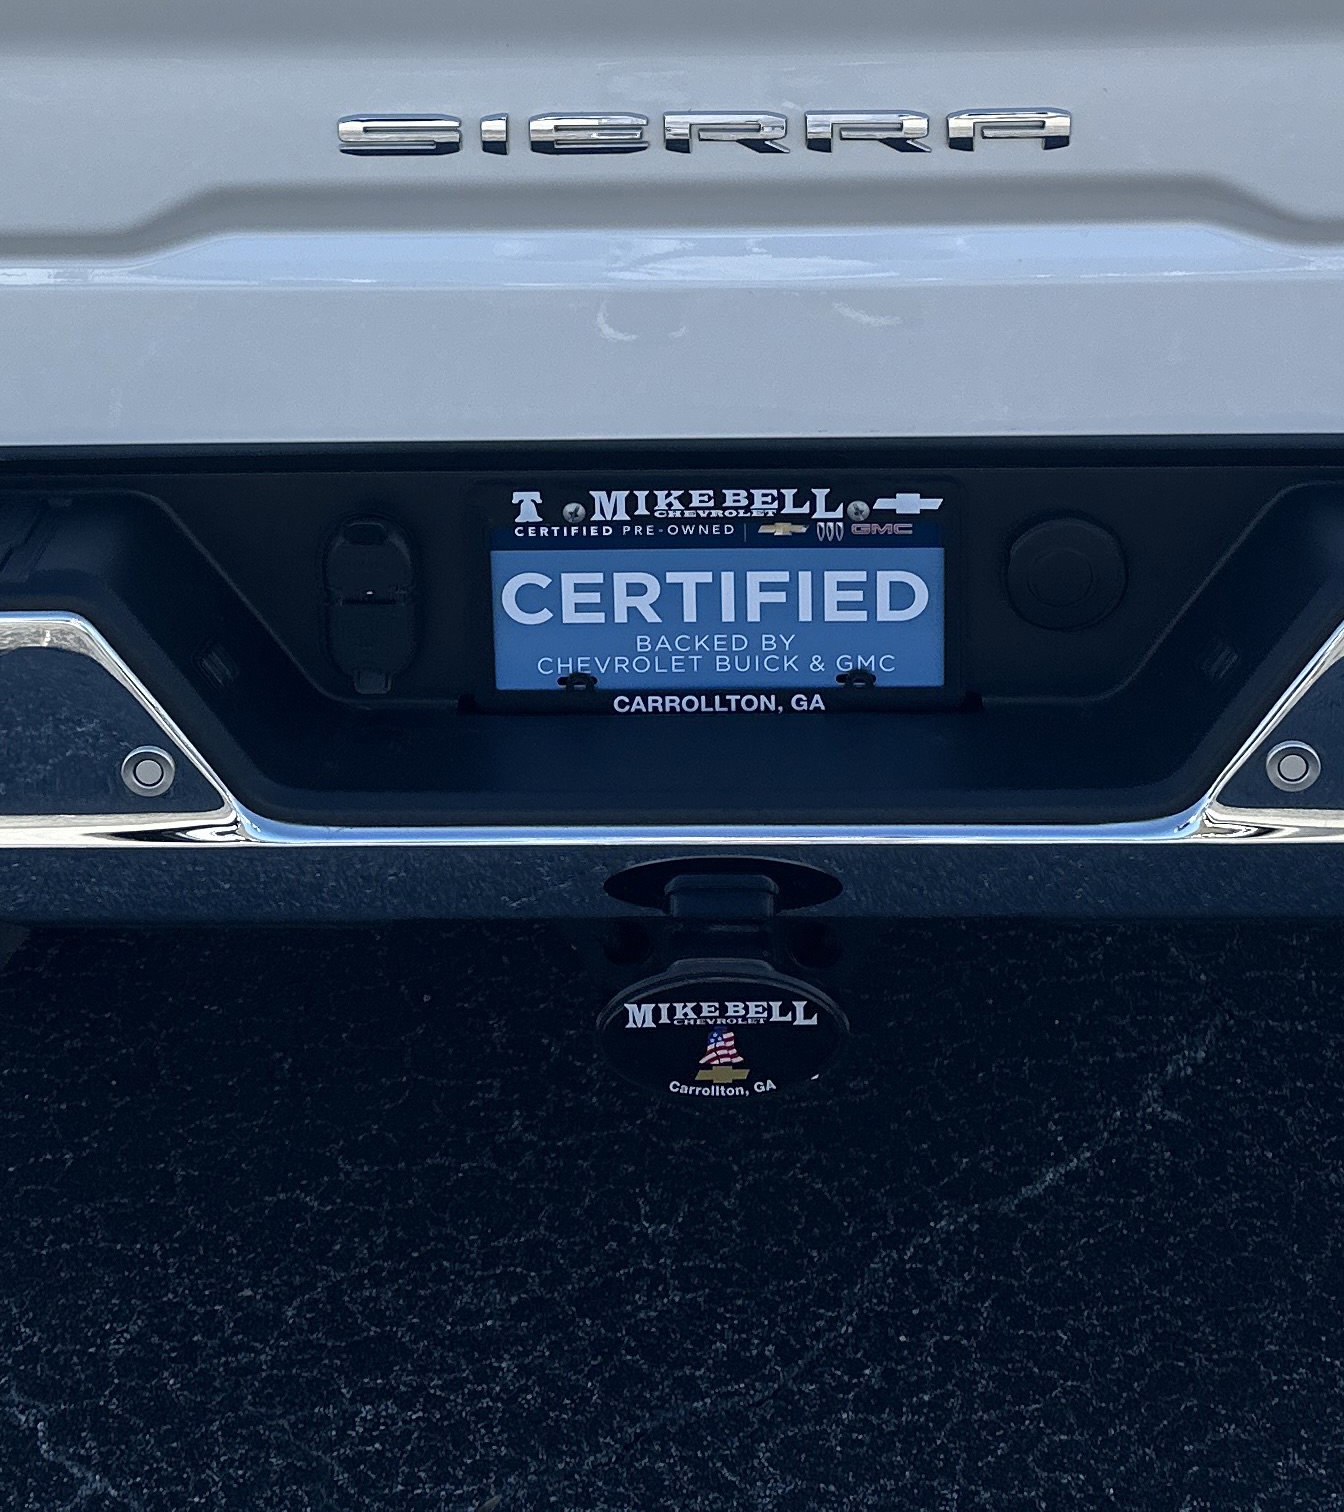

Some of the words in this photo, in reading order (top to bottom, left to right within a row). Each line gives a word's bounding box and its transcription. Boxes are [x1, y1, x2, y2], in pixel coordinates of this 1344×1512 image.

[337, 109, 1071, 155] SIERRA
[588, 489, 715, 522] MIKE
[721, 488, 845, 520] BELL
[653, 509, 778, 519] CHEVROLET
[514, 525, 613, 538] CERTIFIED
[622, 524, 736, 536] PRE-OWNED
[851, 522, 914, 536] GMC
[500, 570, 930, 626] CERTIFIED
[636, 634, 749, 654] BACKED
[761, 634, 797, 652] BY
[536, 654, 704, 676] CHEVROLET
[715, 654, 800, 674] BUICK
[809, 655, 826, 673] &
[836, 653, 897, 674] GMC
[612, 694, 784, 714] CARROLLTON,
[791, 693, 827, 712] GA
[623, 1001, 720, 1029] MIKE
[724, 1000, 819, 1026] BELL
[672, 1017, 768, 1026] CHEVROLET
[668, 1080, 750, 1097] Carrollton,
[754, 1080, 776, 1092] GA
